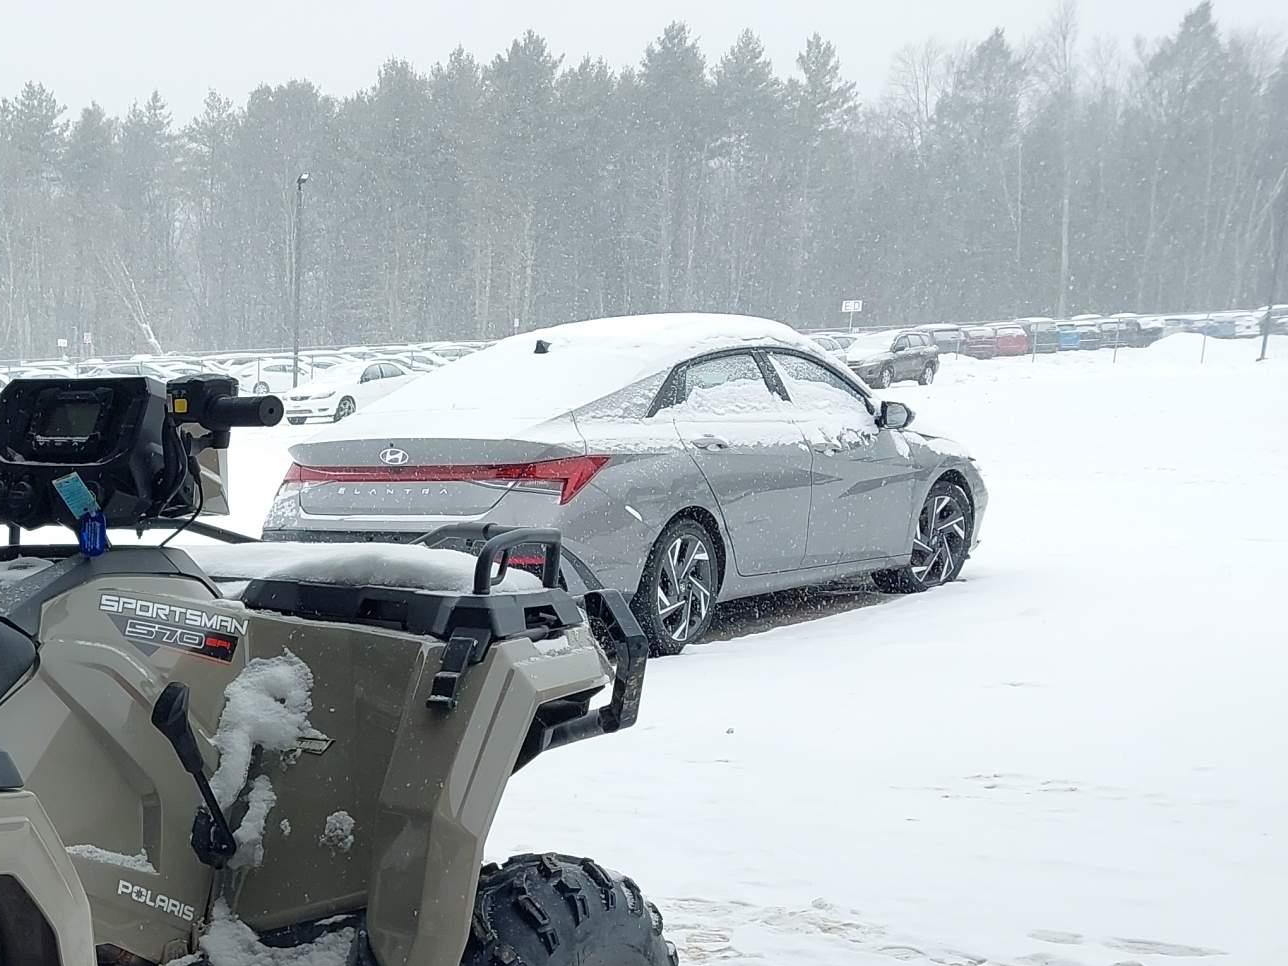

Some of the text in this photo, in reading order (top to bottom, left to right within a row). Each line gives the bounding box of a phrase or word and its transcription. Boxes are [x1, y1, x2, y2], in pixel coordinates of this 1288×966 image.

[338, 488, 447, 496] ELANTRA
[101, 594, 249, 635] SPORTSMAN
[125, 620, 206, 649] 570
[118, 879, 195, 922] POLARIS
